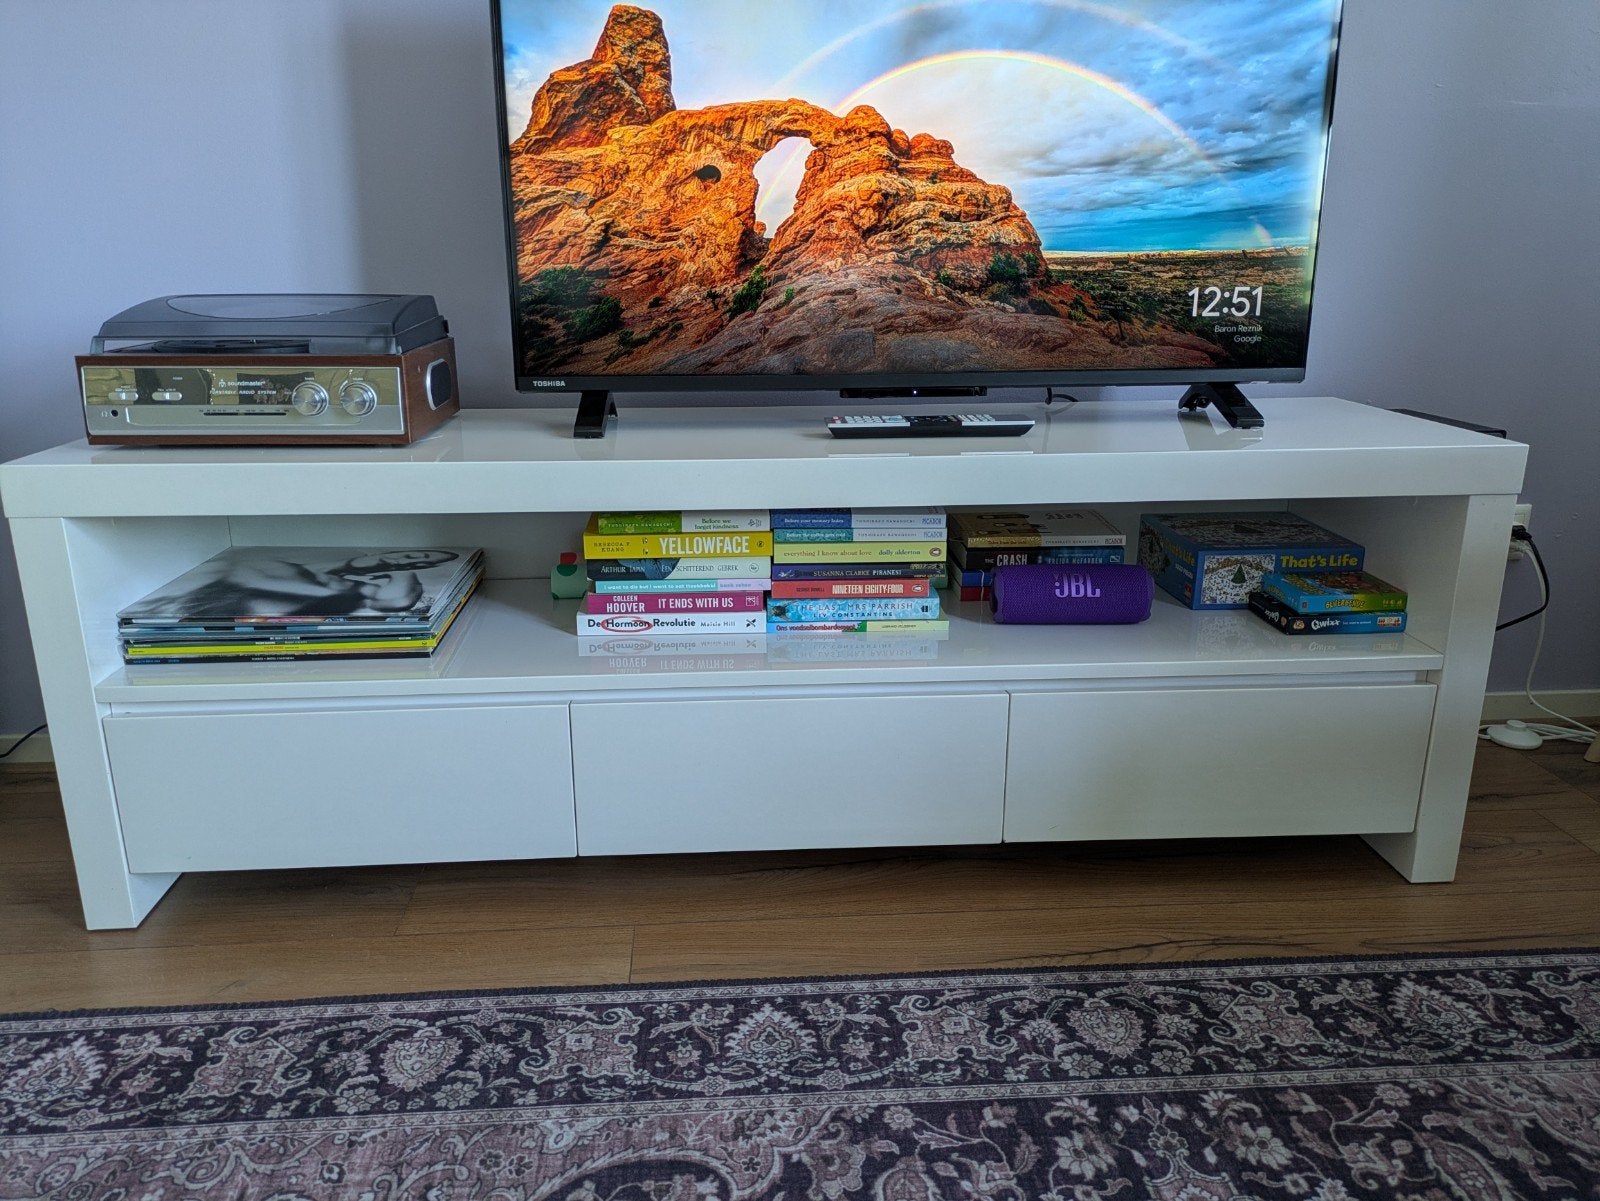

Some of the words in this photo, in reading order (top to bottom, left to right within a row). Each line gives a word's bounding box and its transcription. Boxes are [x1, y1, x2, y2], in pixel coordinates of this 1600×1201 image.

[1188, 286, 1263, 317] 12:51
[1214, 325, 1237, 333] Baron
[1238, 324, 1263, 332] Reznik
[1233, 334, 1262, 343] Google
[659, 536, 750, 555] YELLOWFACE
[784, 548, 816, 557] everything
[996, 554, 1028, 566] CRASH
[1280, 554, 1327, 568] That's
[1330, 553, 1358, 568] Life
[600, 565, 626, 573] ARTHUR
[675, 564, 714, 572] SCHITTEREND
[832, 584, 864, 594] NINETEEN
[864, 584, 904, 594] EIGHTY-FOUR
[1055, 574, 1100, 598] JBL
[606, 602, 646, 613] HOOVER
[658, 598, 667, 609] IT
[669, 598, 693, 608] ENDS
[695, 598, 720, 608] WITH
[722, 597, 734, 608] US
[588, 618, 601, 628] De
[606, 618, 650, 628] Hormoon
[653, 618, 696, 628] Revolutie
[1311, 618, 1340, 630] Qwixx
